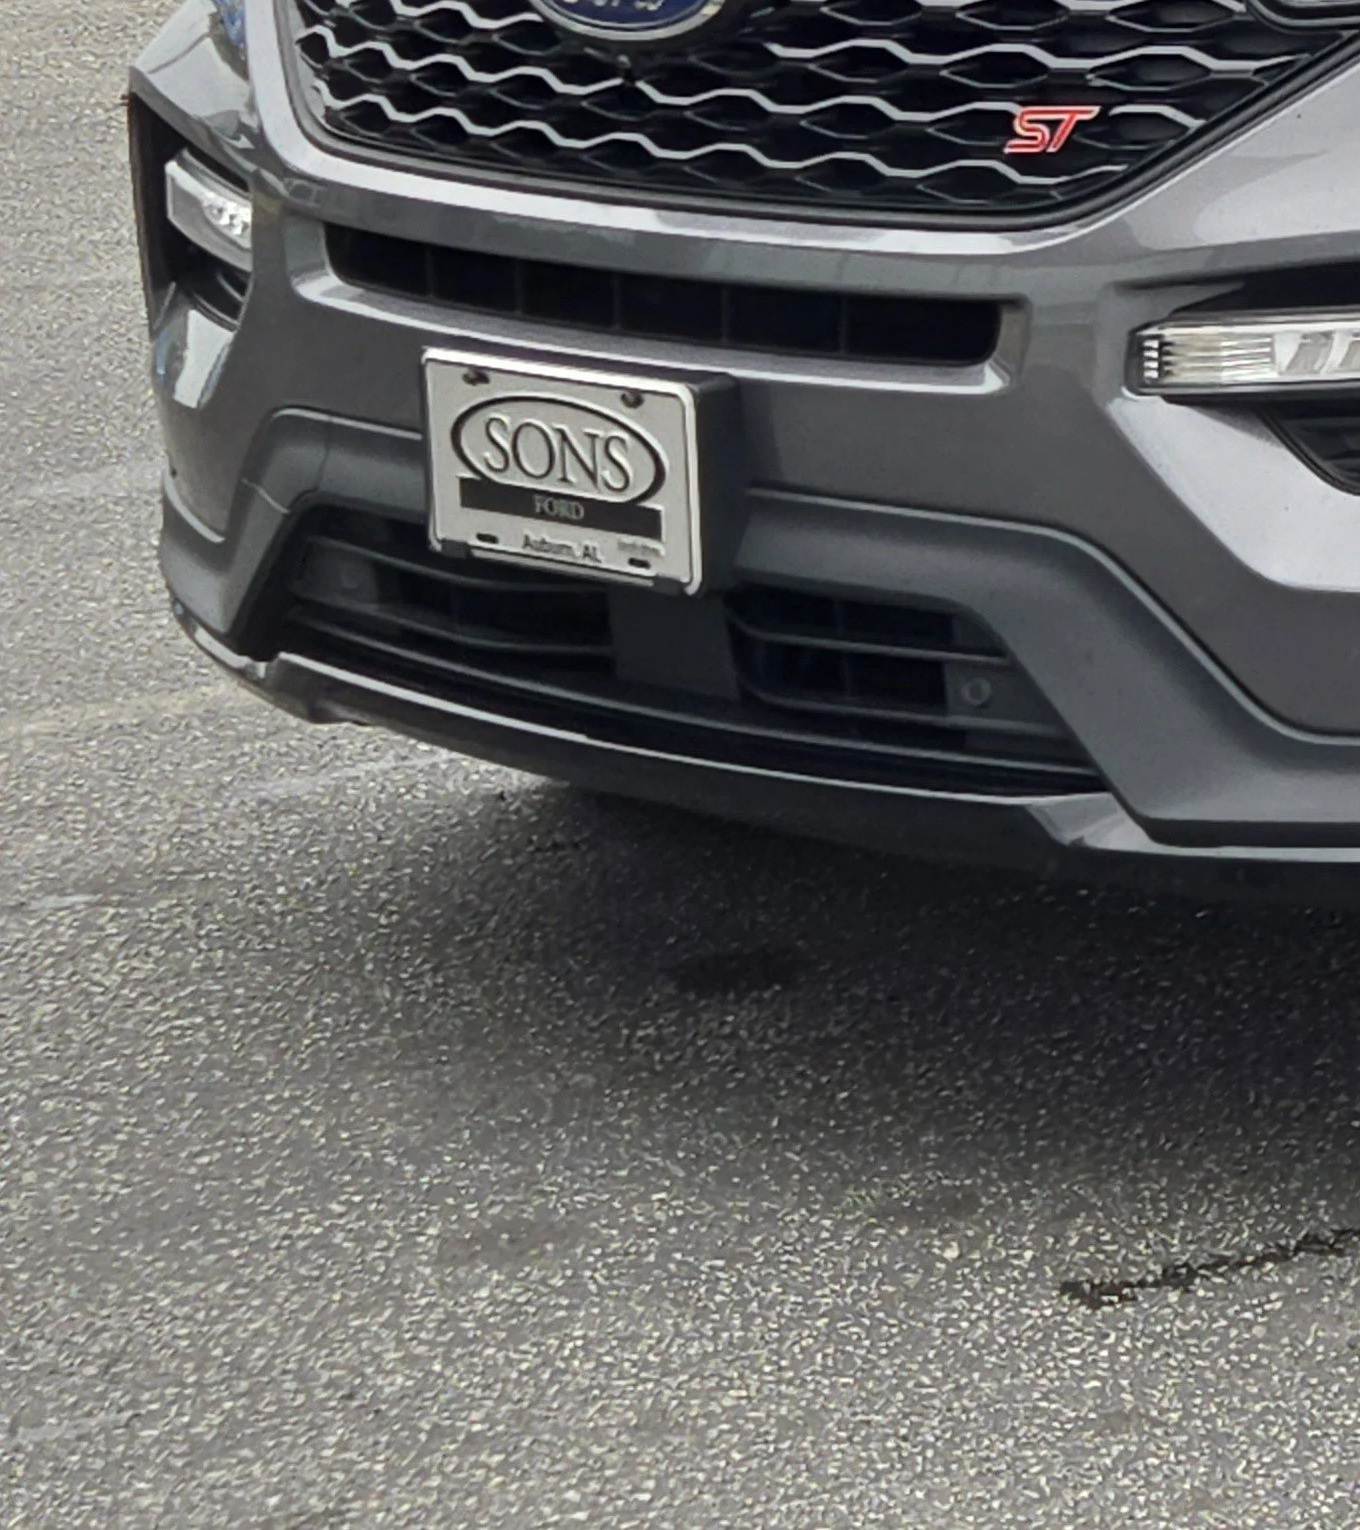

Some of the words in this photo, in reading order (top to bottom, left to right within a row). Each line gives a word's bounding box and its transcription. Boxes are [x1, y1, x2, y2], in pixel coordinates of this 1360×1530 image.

[1003, 105, 1101, 154] ST
[483, 415, 631, 494] SONS
[534, 494, 584, 520] FORD
